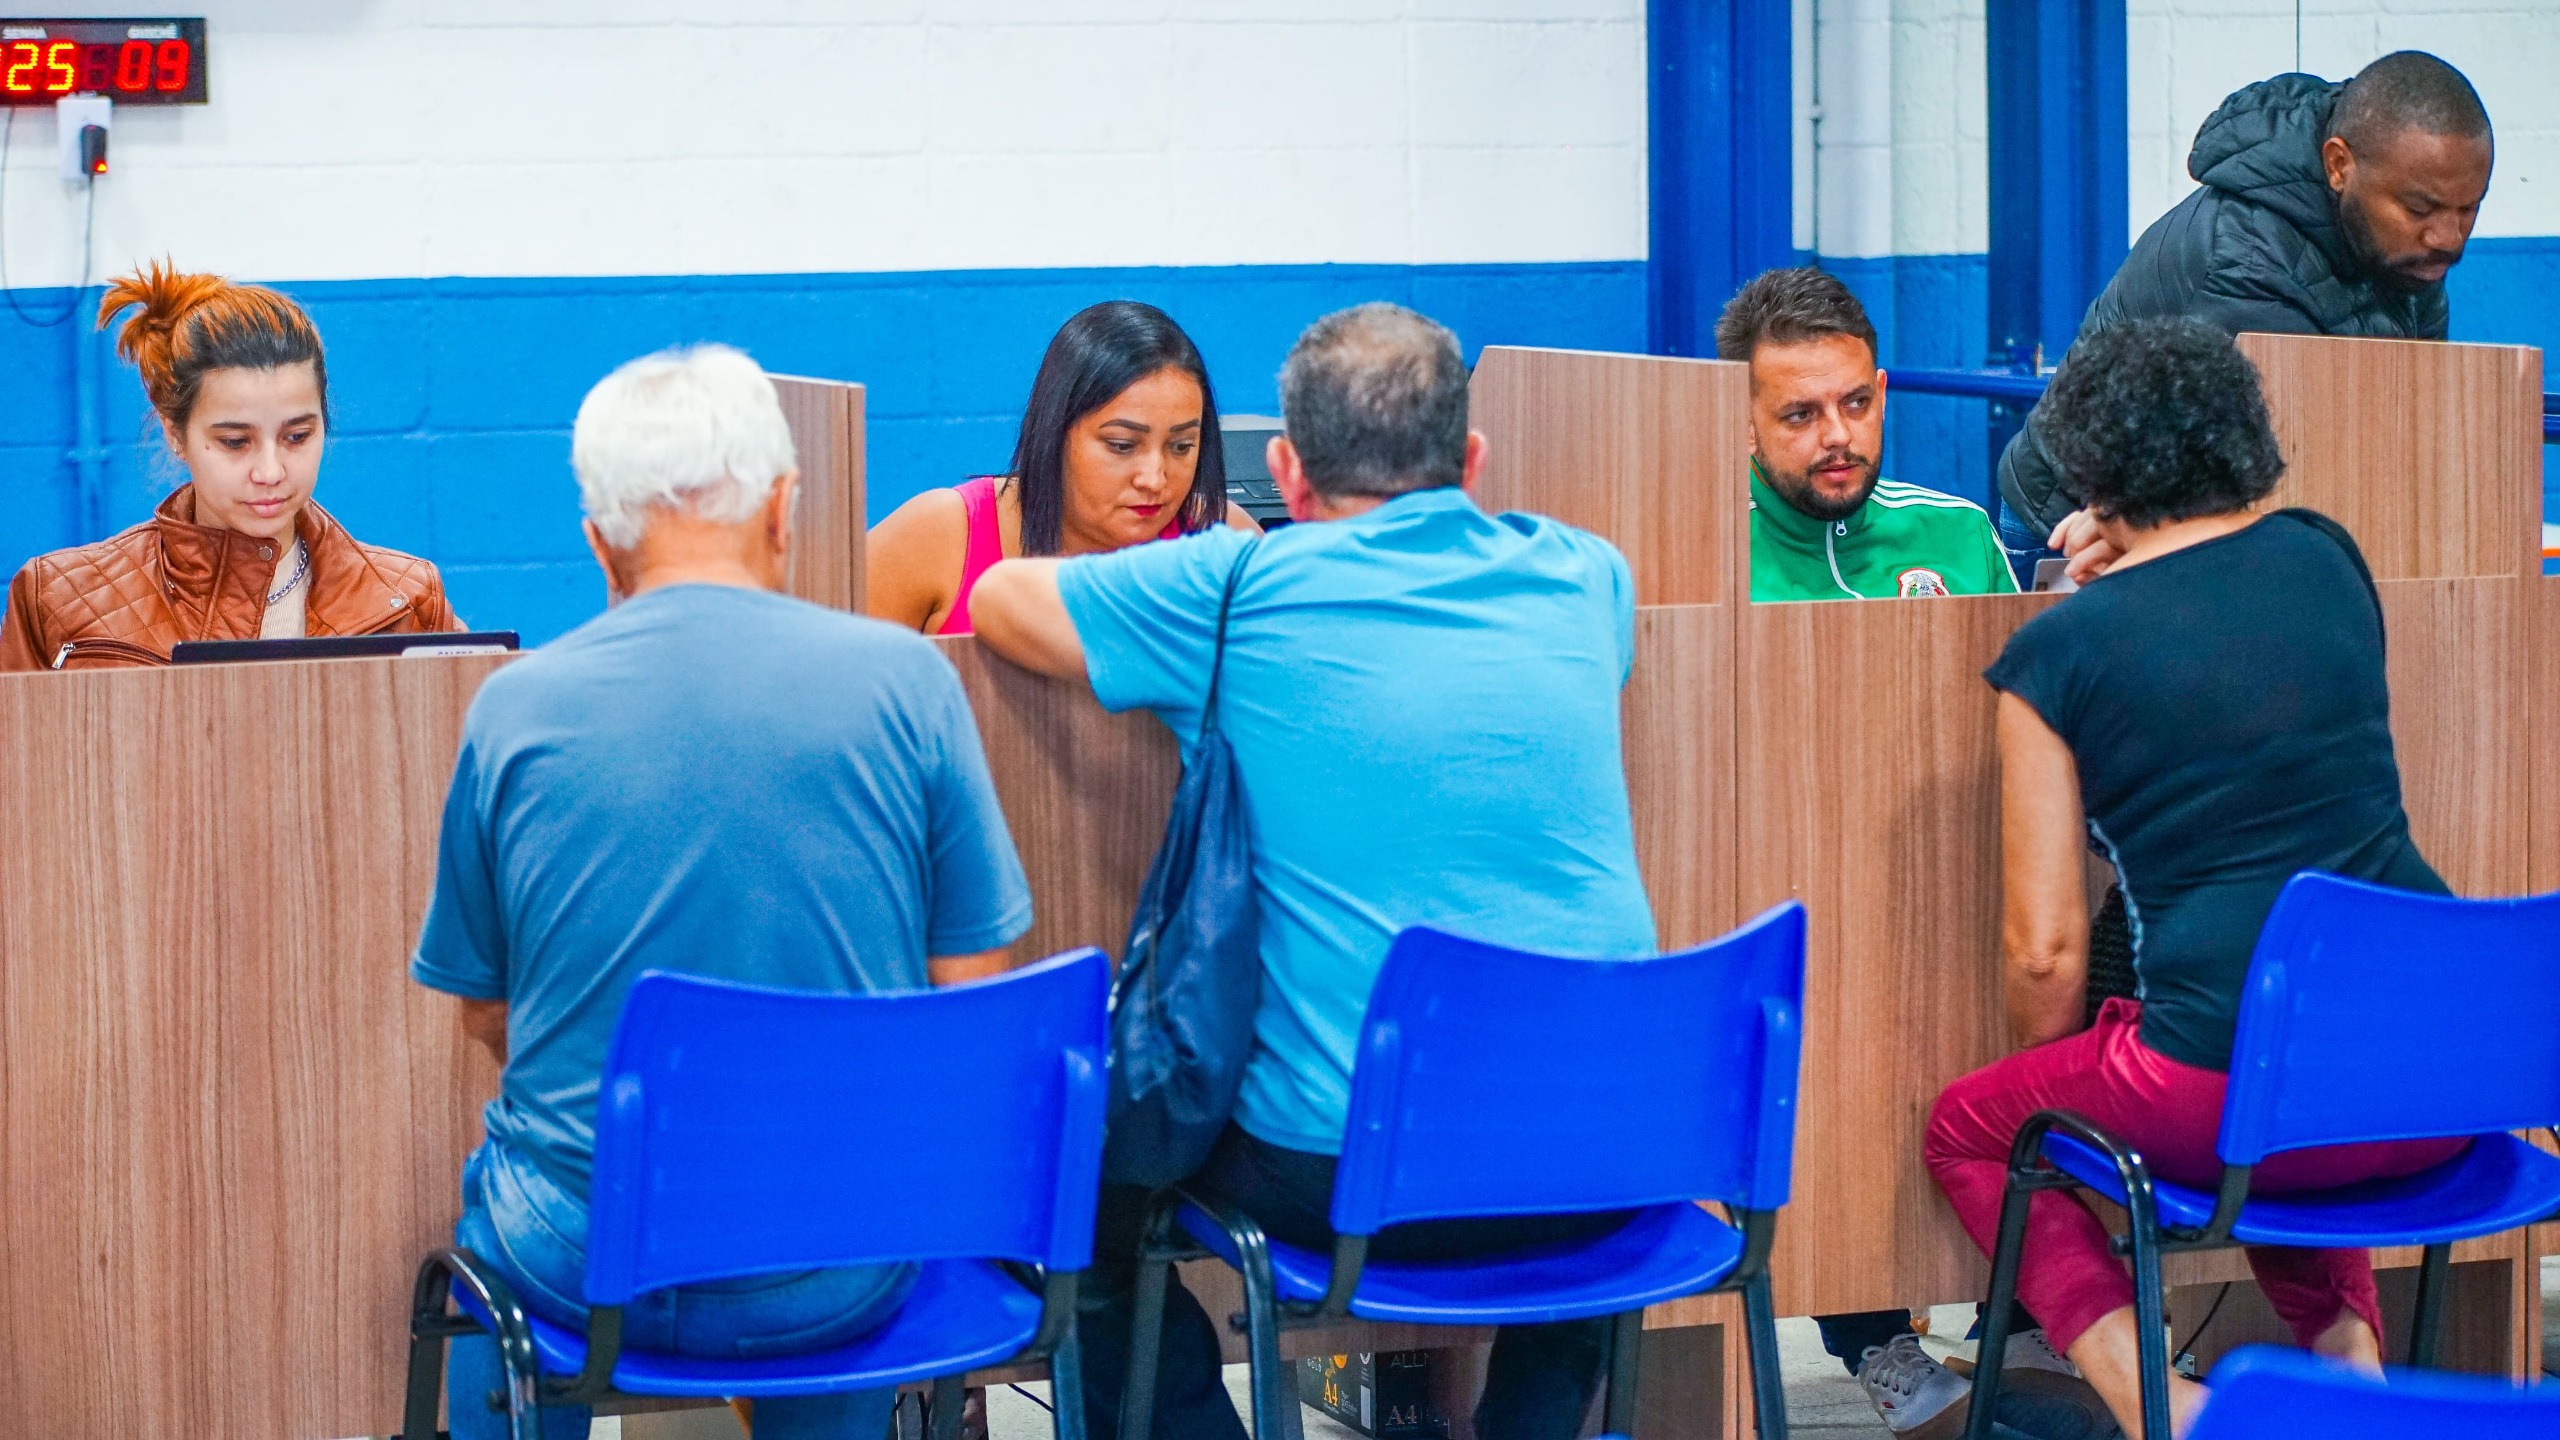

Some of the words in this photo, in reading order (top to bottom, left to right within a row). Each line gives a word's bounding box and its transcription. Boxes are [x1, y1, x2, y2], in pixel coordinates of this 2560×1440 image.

[0, 41, 76, 91] 25
[115, 39, 190, 92] 09
[1323, 1377, 1339, 1407] A4
[1385, 1405, 1418, 1425] A4
